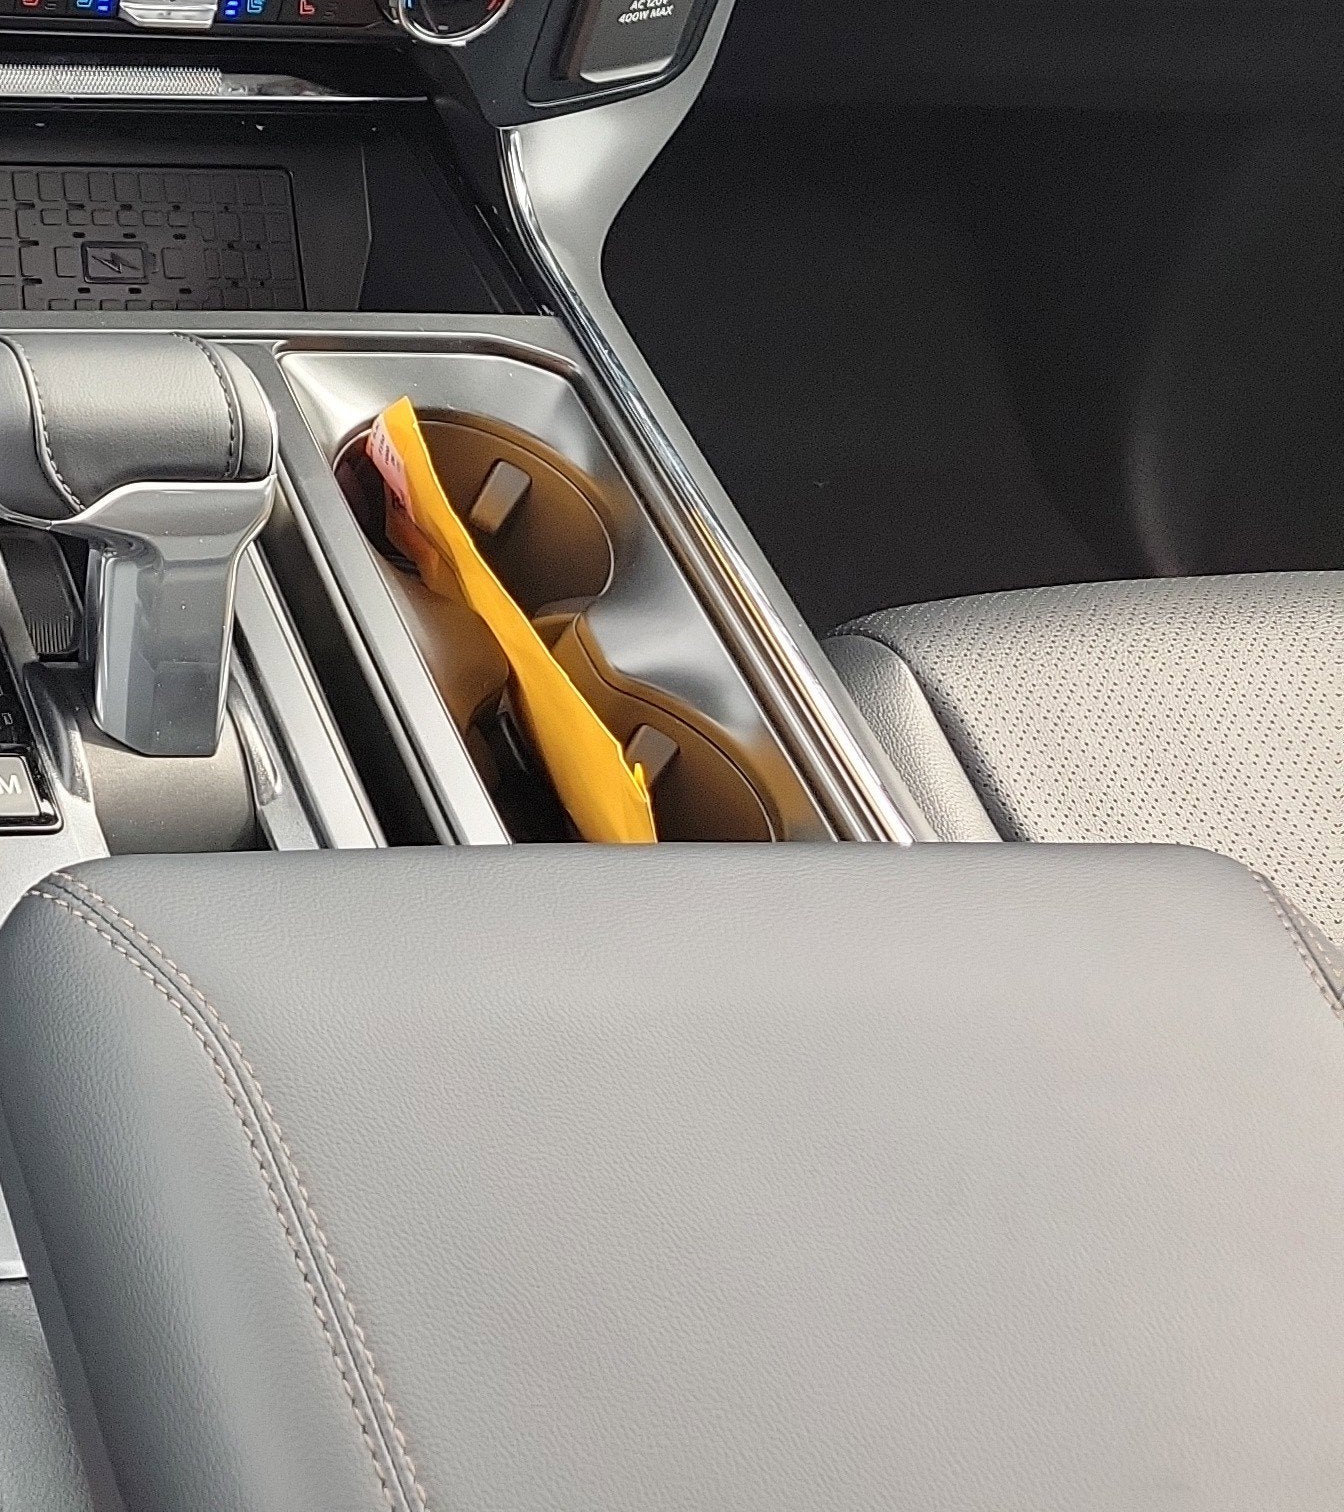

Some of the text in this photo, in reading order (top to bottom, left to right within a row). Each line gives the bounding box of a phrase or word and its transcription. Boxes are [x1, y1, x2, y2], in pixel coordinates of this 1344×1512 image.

[630, 0, 646, 11] AC
[618, 5, 674, 24] 400W MAX
